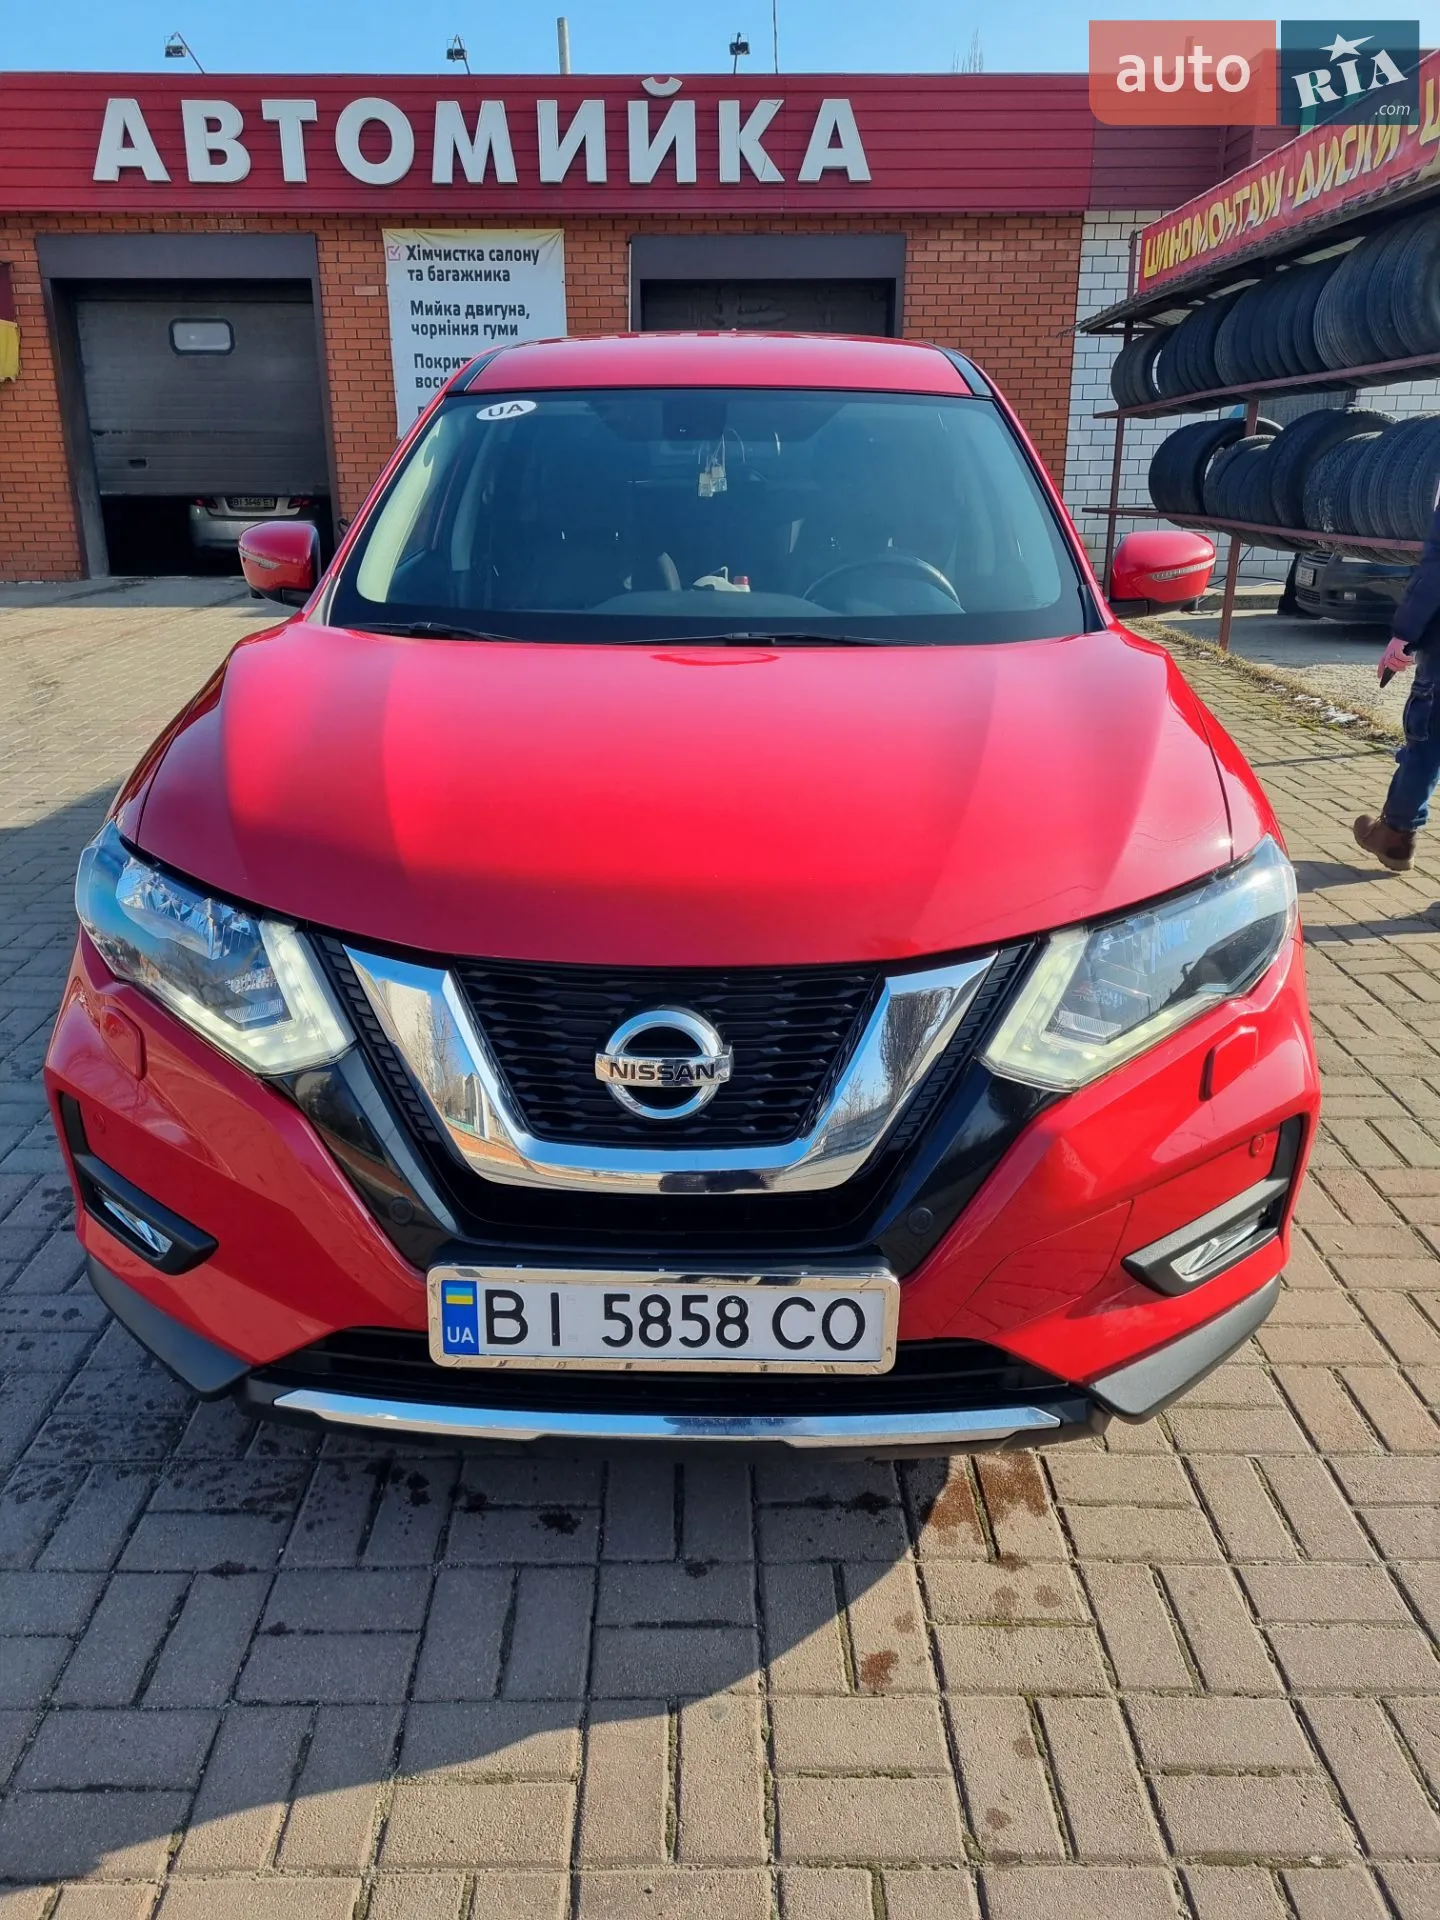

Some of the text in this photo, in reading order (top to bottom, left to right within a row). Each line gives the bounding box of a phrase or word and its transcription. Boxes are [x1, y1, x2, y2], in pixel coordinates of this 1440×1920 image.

[92, 76, 873, 185] АВТОМИЙКА
[1143, 165, 1285, 278] ШИНОМОНТАЖ
[406, 244, 540, 266] Хімчистка салону
[407, 265, 511, 282] та багажника
[410, 300, 531, 320] Мийка двигуна,
[411, 319, 519, 340] чорніння гуми
[488, 403, 524, 417] UA
[608, 1062, 716, 1081] NISSAN
[446, 1288, 866, 1351] UA BI 5858 CO
